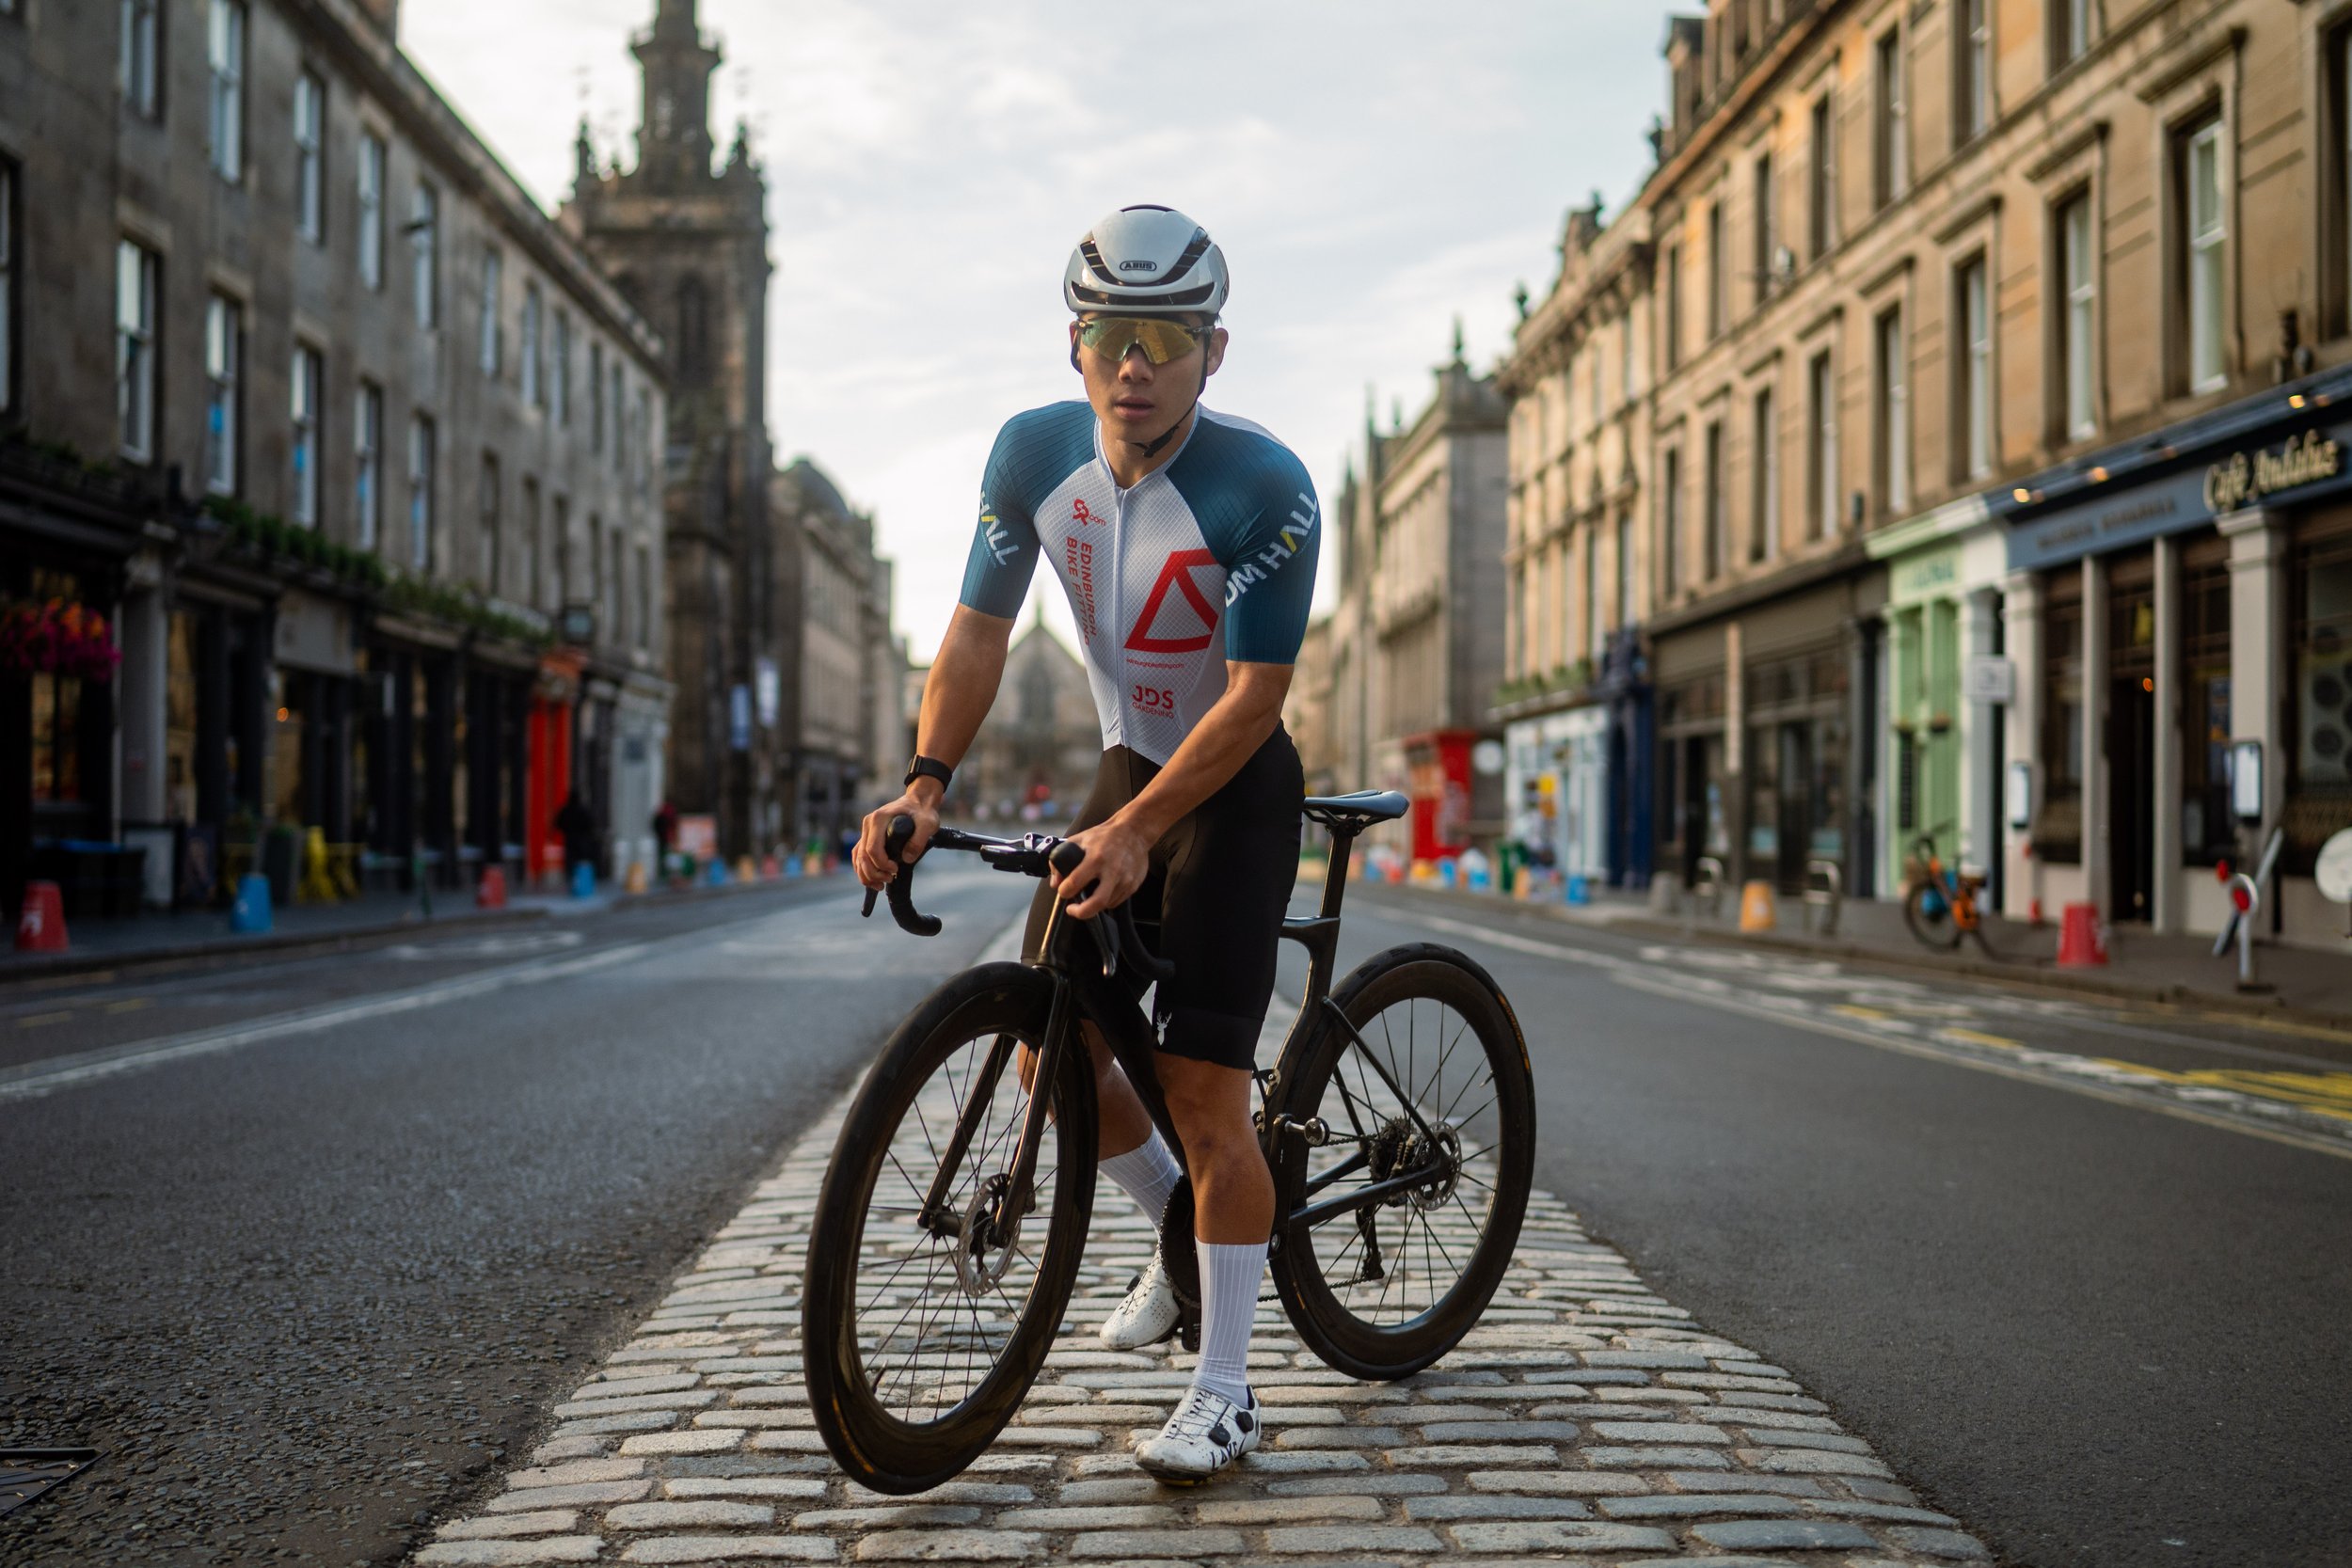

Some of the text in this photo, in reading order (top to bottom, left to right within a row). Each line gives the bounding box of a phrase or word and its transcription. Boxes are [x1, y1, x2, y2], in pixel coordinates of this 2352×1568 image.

[1258, 492, 1317, 570] HALL
[1066, 535, 1090, 647] BIKE FITTING
[1081, 542, 1097, 637] EDINBURGH
[1132, 684, 1174, 710] JDS
